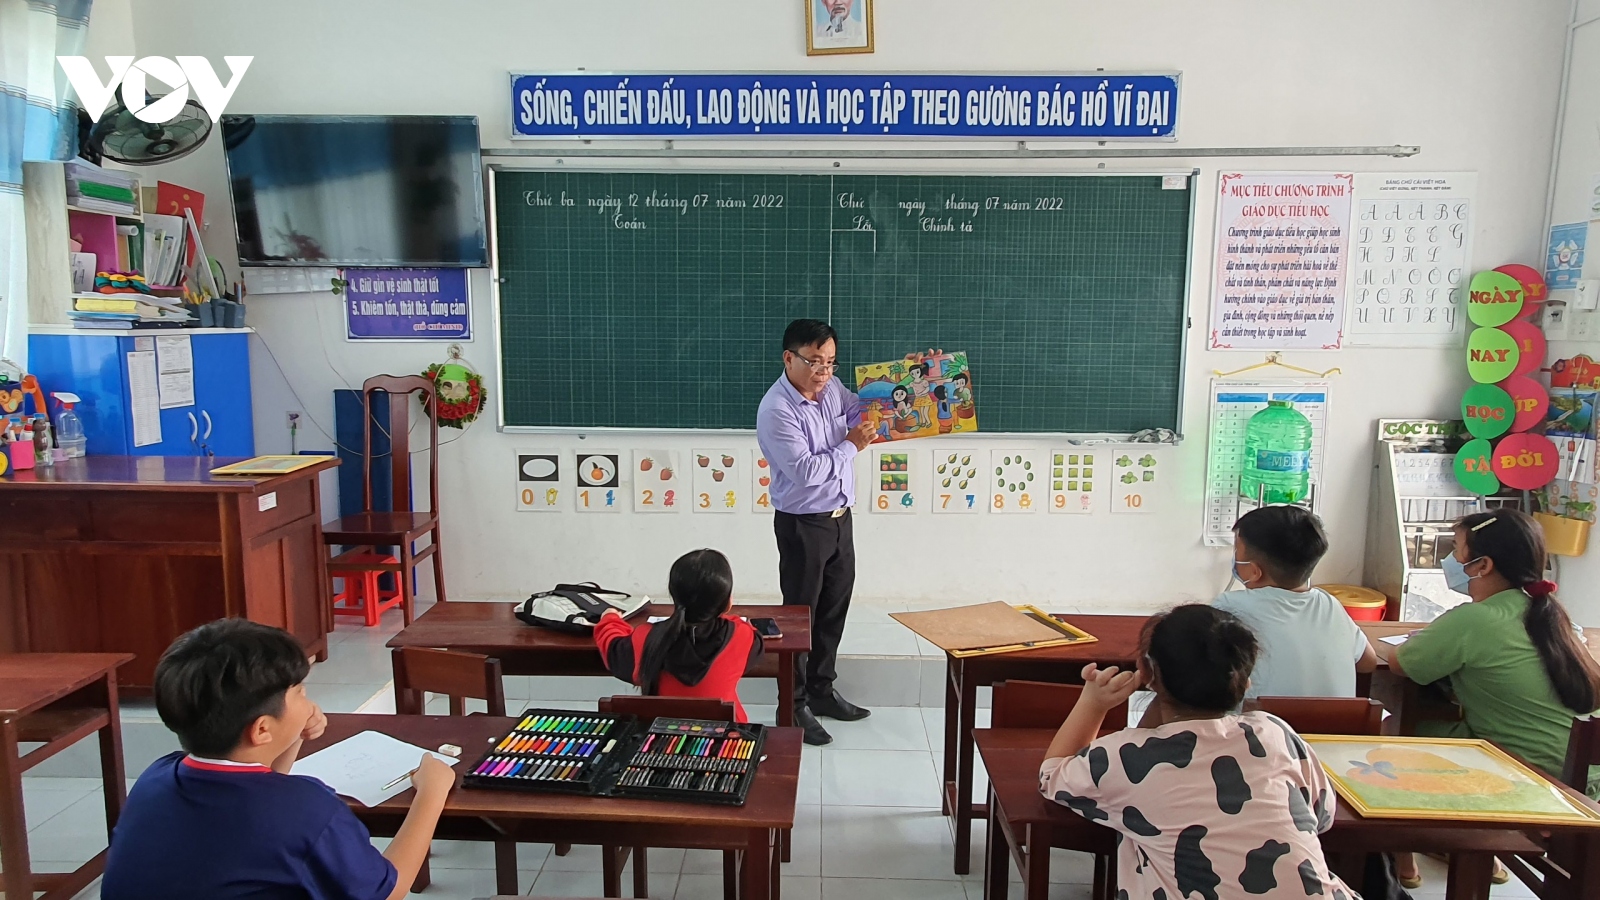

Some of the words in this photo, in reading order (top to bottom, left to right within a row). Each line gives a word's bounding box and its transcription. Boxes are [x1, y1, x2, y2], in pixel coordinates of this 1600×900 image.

[520, 78, 578, 129] SỐNG,
[584, 78, 642, 125] CHIẾN
[647, 78, 691, 129] ĐẤU,
[697, 89, 732, 125] LAO
[738, 81, 790, 132] ĐỘNG
[796, 82, 820, 125] VÀ
[827, 88, 864, 132] HỌC
[870, 82, 906, 132] TẬP
[911, 89, 960, 125] THEO
[966, 85, 1031, 126] GƯƠNG
[1037, 83, 1075, 126] BÁC
[1080, 80, 1110, 126] HỒ
[1113, 84, 1133, 126] VĨ
[1136, 90, 1169, 133] ĐẠI
[1230, 185, 1251, 198] MỤC
[1253, 182, 1273, 196] TIÊU
[1274, 184, 1313, 196] CHƯƠNG
[1316, 182, 1344, 196] TRÌNH
[523, 190, 552, 207] Thứ
[561, 191, 575, 207] ba
[588, 194, 622, 214] ngày
[628, 194, 639, 207] 12
[645, 190, 688, 215] tháng
[693, 194, 709, 208] 07
[716, 195, 746, 208] năm
[753, 194, 784, 208] 2022
[899, 198, 926, 216] ngày
[945, 193, 979, 217] tháng
[985, 196, 1000, 210] 07
[1003, 199, 1031, 210] năm
[1035, 197, 1063, 210] 2022
[1242, 203, 1265, 216] GIÁO
[1267, 205, 1286, 218] DỤC
[1288, 200, 1308, 216] TIỂU
[1310, 205, 1330, 218] HỌC
[612, 213, 646, 229] Toán
[360, 277, 371, 292] Giữ
[387, 278, 395, 296] vệ
[397, 278, 412, 292] sinh
[413, 277, 428, 296] thật
[429, 276, 439, 292] tốt
[1469, 286, 1521, 304] NGÀY
[352, 301, 360, 316] 5.
[361, 300, 384, 316] Khiêm
[385, 299, 399, 317] tốn,
[400, 300, 414, 318] thật
[431, 300, 449, 317] dũng
[450, 298, 466, 316] cảm
[1470, 349, 1510, 362] NAY
[1466, 405, 1505, 423] HỌC
[1500, 449, 1544, 468] ĐỜI
[522, 488, 534, 505] 0
[580, 491, 590, 507] 1
[642, 490, 653, 505] 2
[699, 493, 711, 508] 3
[757, 493, 769, 507] 4
[877, 494, 889, 509] 6
[940, 494, 952, 509] 7
[993, 494, 1004, 509] 8
[1055, 494, 1066, 508] 9
[1124, 494, 1142, 508] 10
